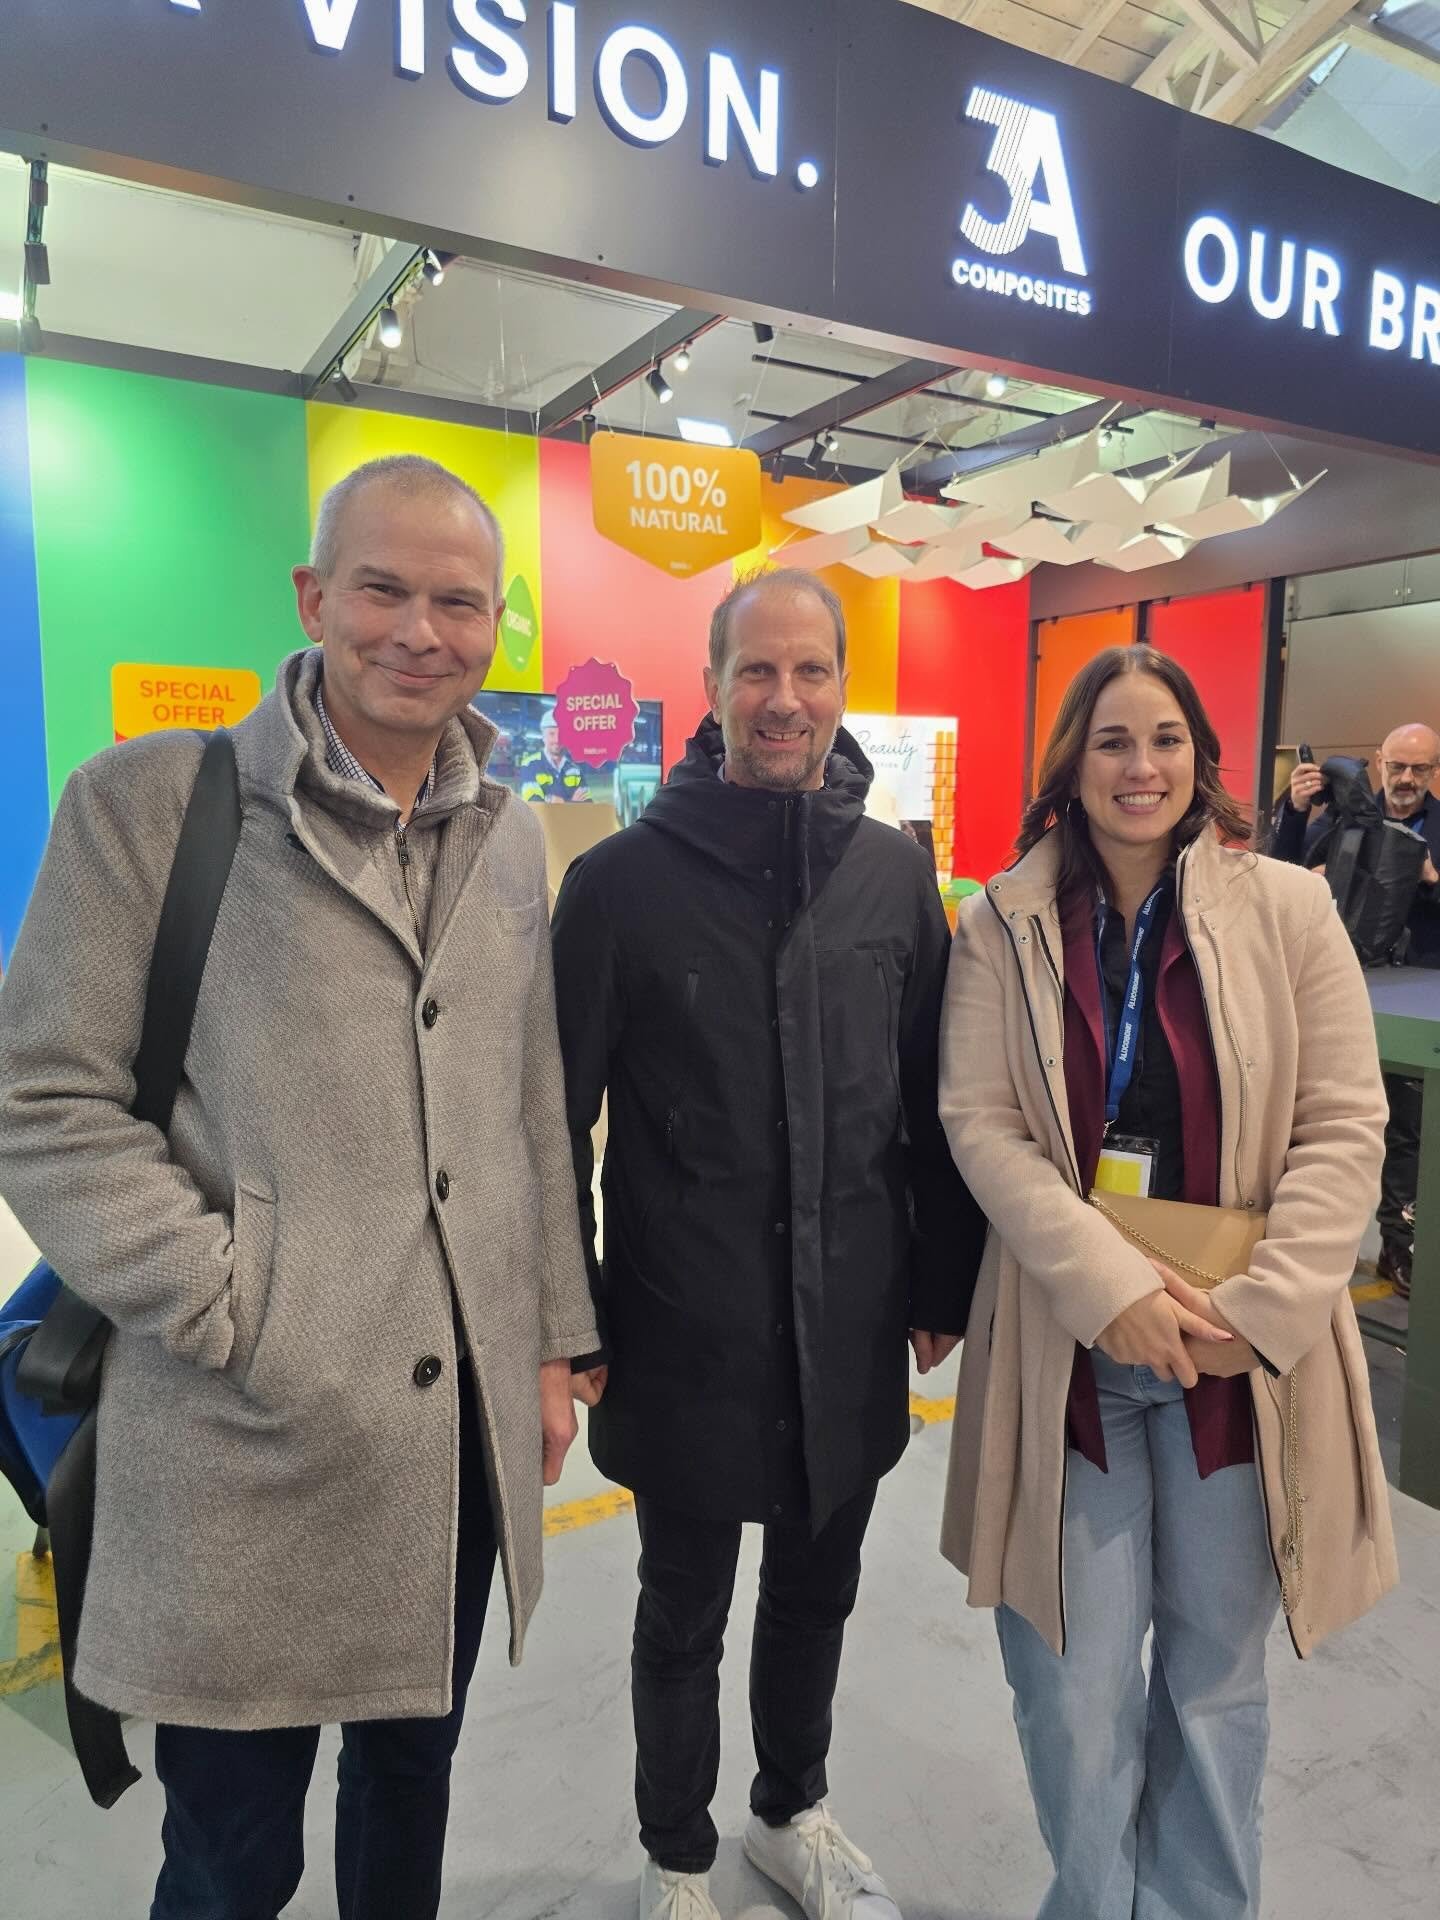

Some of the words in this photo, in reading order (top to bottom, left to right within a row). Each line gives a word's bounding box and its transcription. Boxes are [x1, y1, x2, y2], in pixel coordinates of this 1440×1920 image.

[965, 86, 1088, 276] 3A
[952, 258, 1091, 316] COMPOSITES
[1184, 216, 1341, 338] OUR
[1369, 269, 1440, 366] BR
[626, 460, 727, 508] 100%
[630, 506, 729, 535] NATURAL
[140, 680, 236, 702] SPECIAL
[566, 693, 623, 711] SPECIAL
[152, 704, 225, 724] OFFER
[573, 714, 617, 731] OFFER
[856, 729, 918, 771] Beauty
